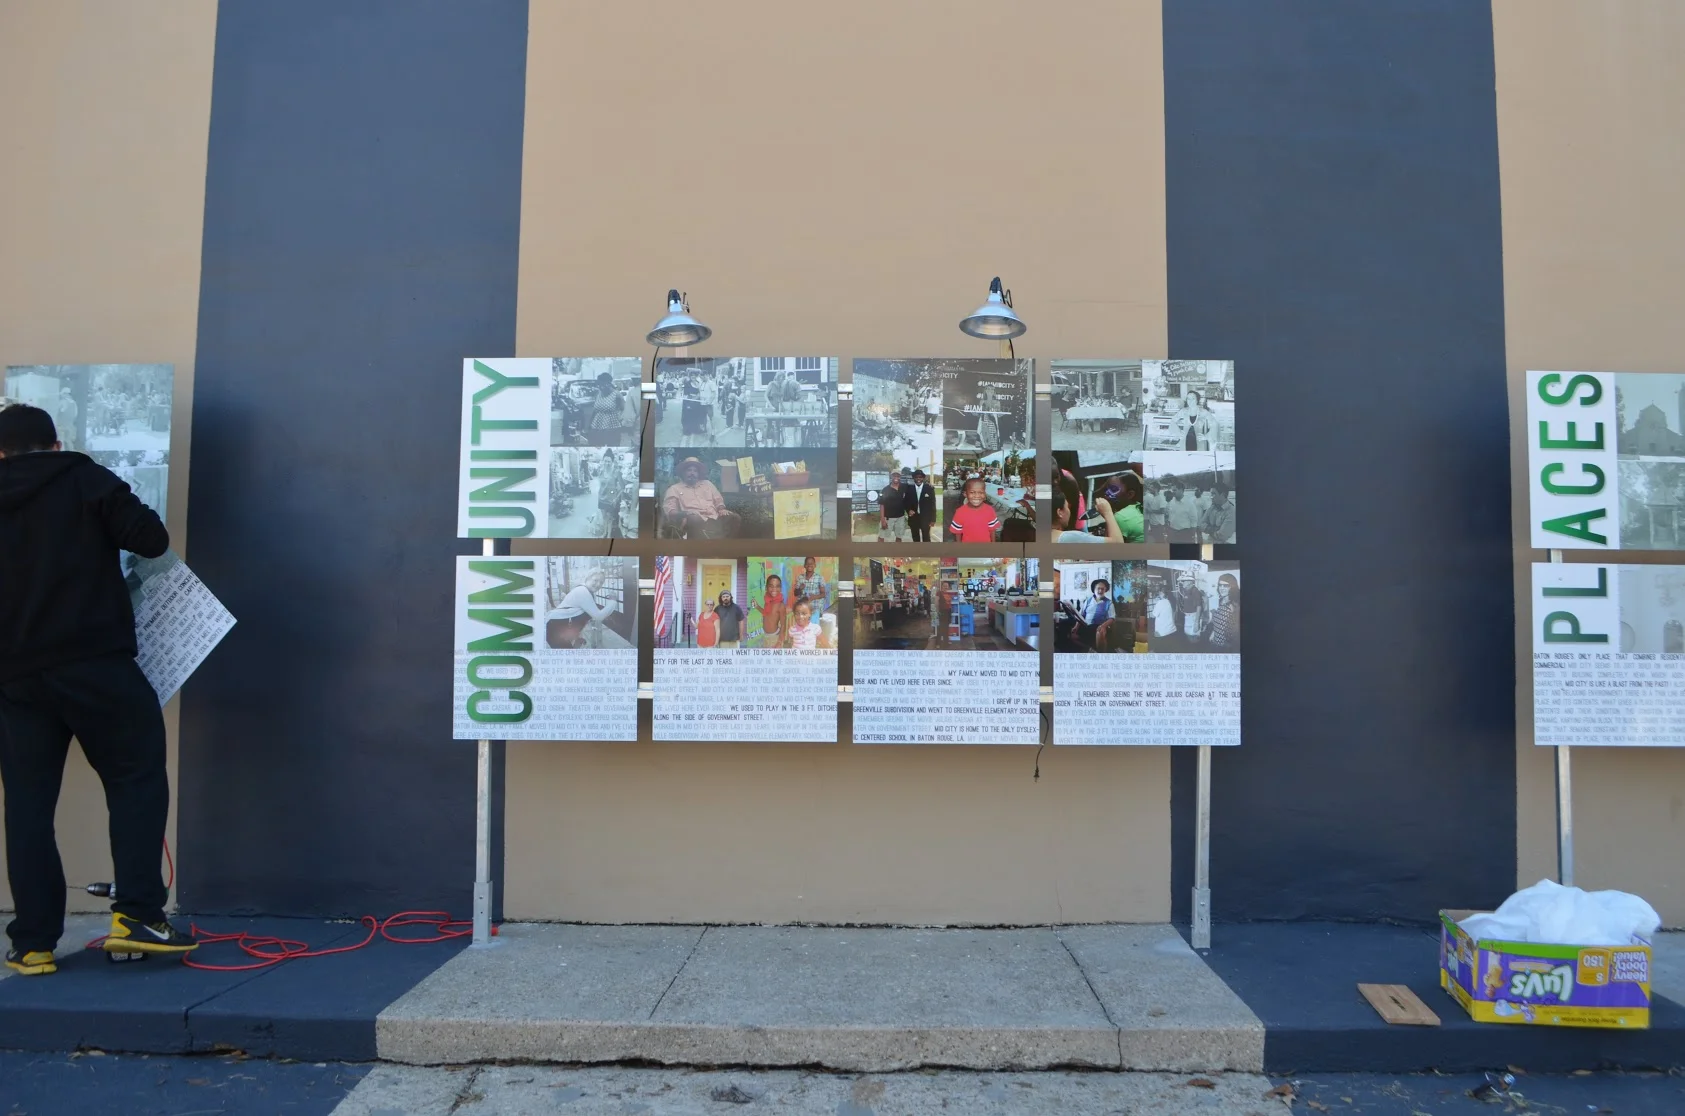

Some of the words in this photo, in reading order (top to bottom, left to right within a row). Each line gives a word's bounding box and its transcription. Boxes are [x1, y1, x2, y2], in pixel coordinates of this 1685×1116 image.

[1538, 374, 1609, 643] PLACES
[467, 359, 539, 724] COMMUNITY
[142, 610, 162, 631] PREMIERE
[160, 590, 179, 610] OUTDOOR
[177, 572, 195, 591] CONCERT
[184, 578, 200, 596] CAPITAL
[1510, 964, 1573, 1002] Luvs
[1583, 955, 1604, 967] 150
